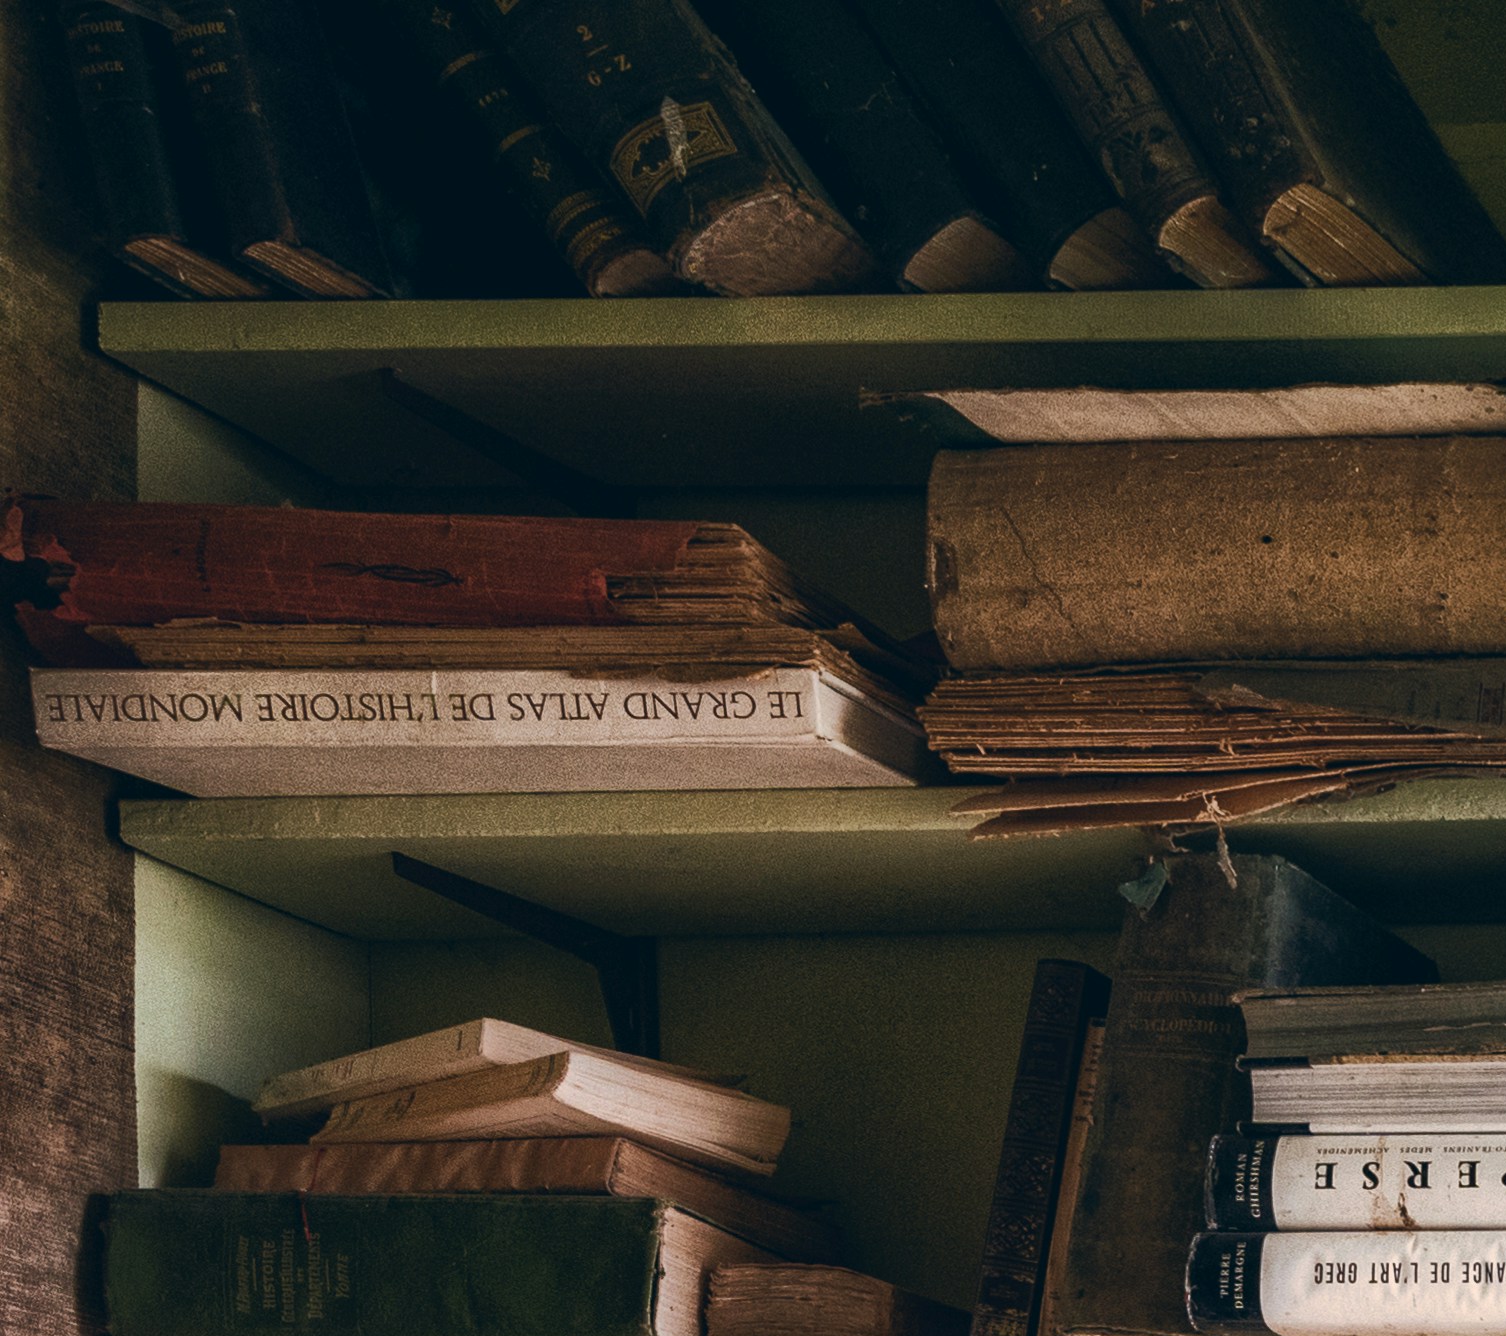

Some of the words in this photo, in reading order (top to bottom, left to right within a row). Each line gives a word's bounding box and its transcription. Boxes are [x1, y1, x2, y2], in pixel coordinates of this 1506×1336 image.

[46, 693, 246, 722] MONDIALE
[255, 693, 439, 722] L'HISTOIRE
[449, 693, 495, 721] DE
[507, 692, 608, 721] ATLAS
[623, 691, 757, 720] GRAND
[768, 691, 803, 718] LE
[1314, 1261, 1358, 1285] GREC
[1369, 1261, 1419, 1285] L'ART
[1427, 1261, 1451, 1284] DE
